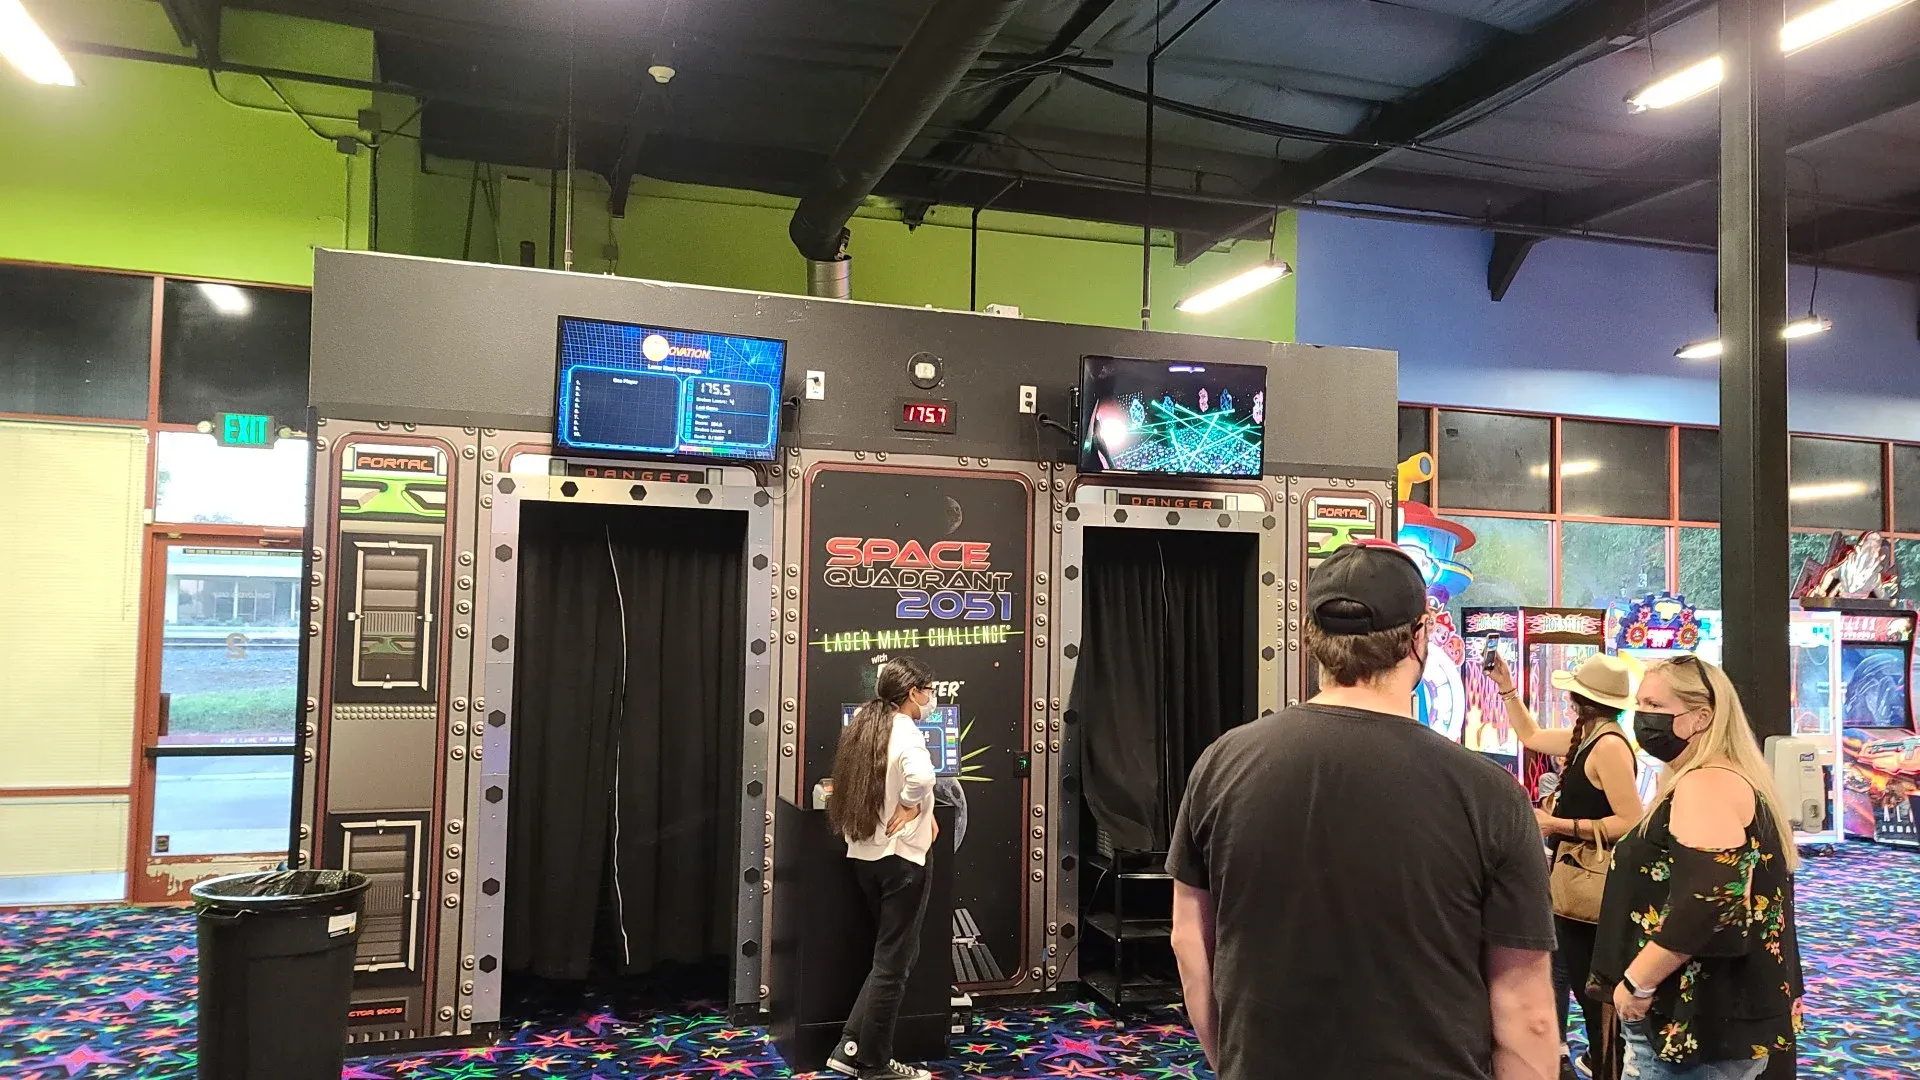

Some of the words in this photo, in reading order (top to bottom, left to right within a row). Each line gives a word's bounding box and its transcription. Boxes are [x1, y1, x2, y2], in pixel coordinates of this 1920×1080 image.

[701, 383, 731, 396] 175.5
[224, 413, 268, 445] EXIT
[358, 457, 433, 471] PORTAL
[585, 468, 689, 483] DANGER
[1132, 496, 1212, 509] DANGER
[1317, 507, 1366, 518] PORTAL
[826, 537, 991, 571] SPACE
[824, 568, 1012, 591] QUADRANT
[896, 590, 1012, 621] 2051
[824, 633, 871, 653] LASER
[878, 629, 920, 649] MAZE
[871, 653, 888, 664] with
